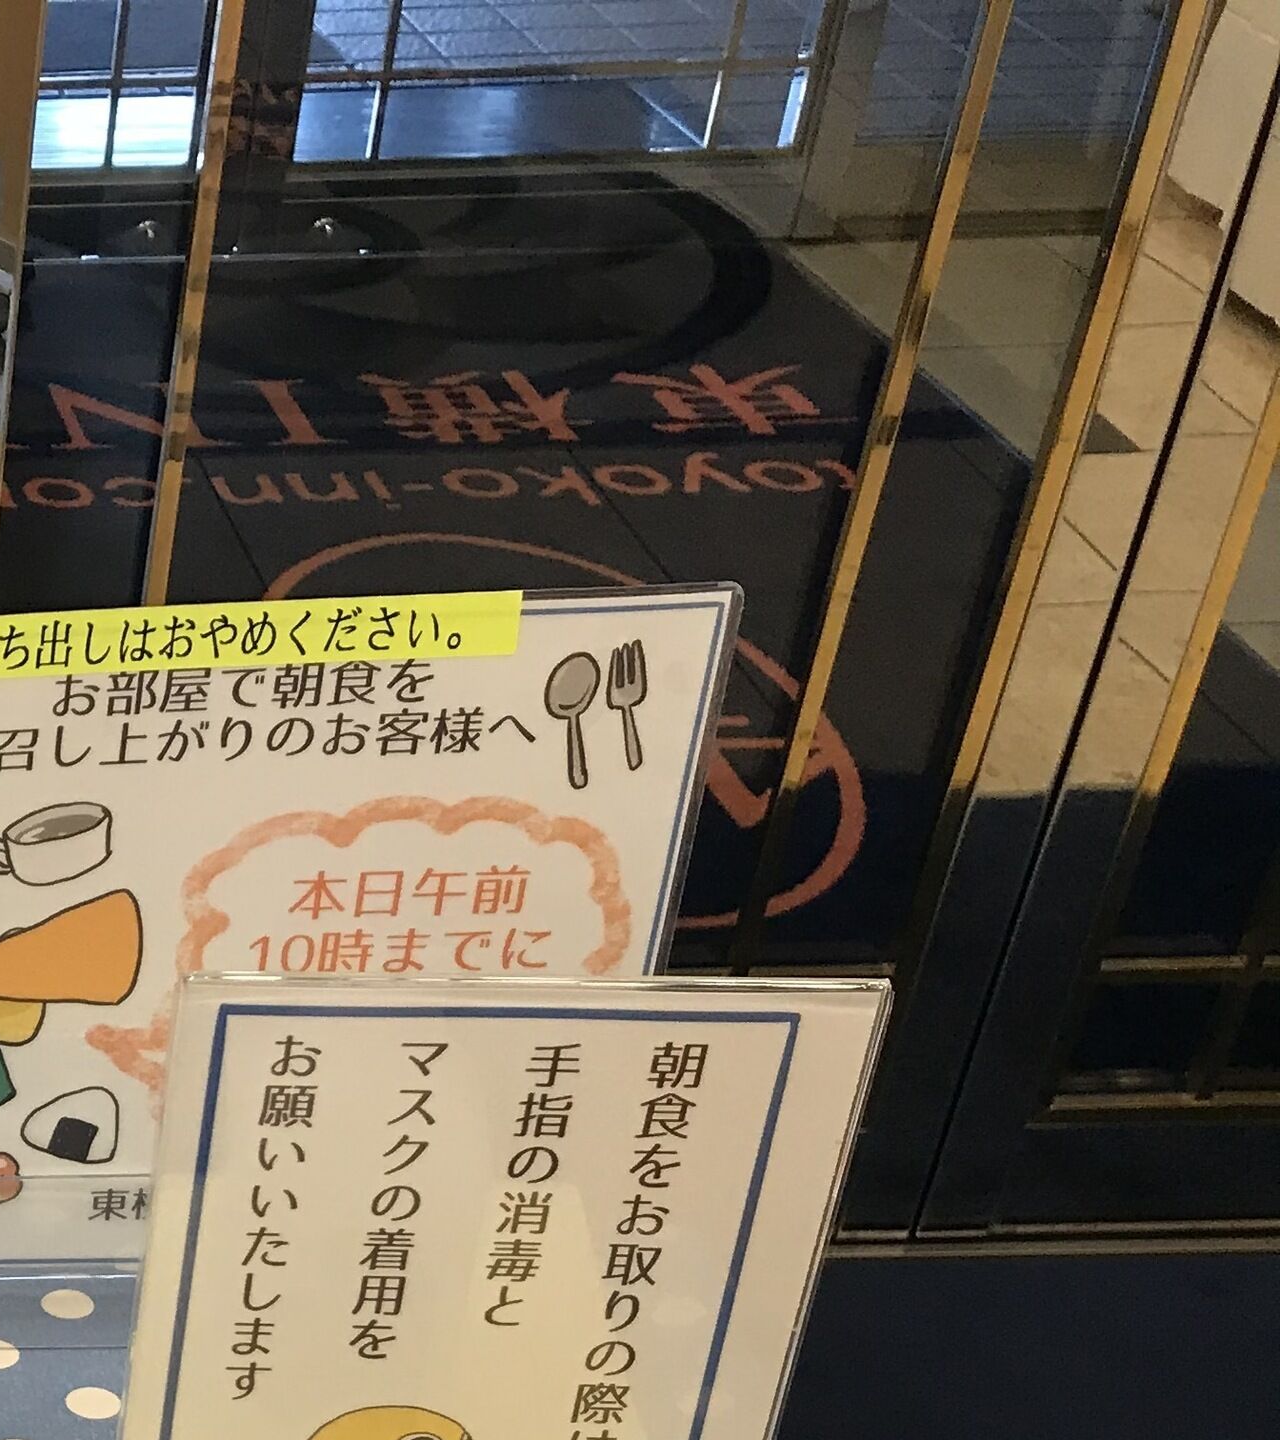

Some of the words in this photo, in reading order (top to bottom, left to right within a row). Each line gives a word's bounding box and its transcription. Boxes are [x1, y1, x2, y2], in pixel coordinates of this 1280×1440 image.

[54, 660, 437, 719] お部屋で朝食を
[249, 926, 550, 974] 10時までに
[288, 867, 530, 920] 本日午前
[224, 1034, 323, 1401] お願いいたします
[348, 1041, 450, 1360] マスクの着用を
[483, 1042, 583, 1329] 手指の消毒と
